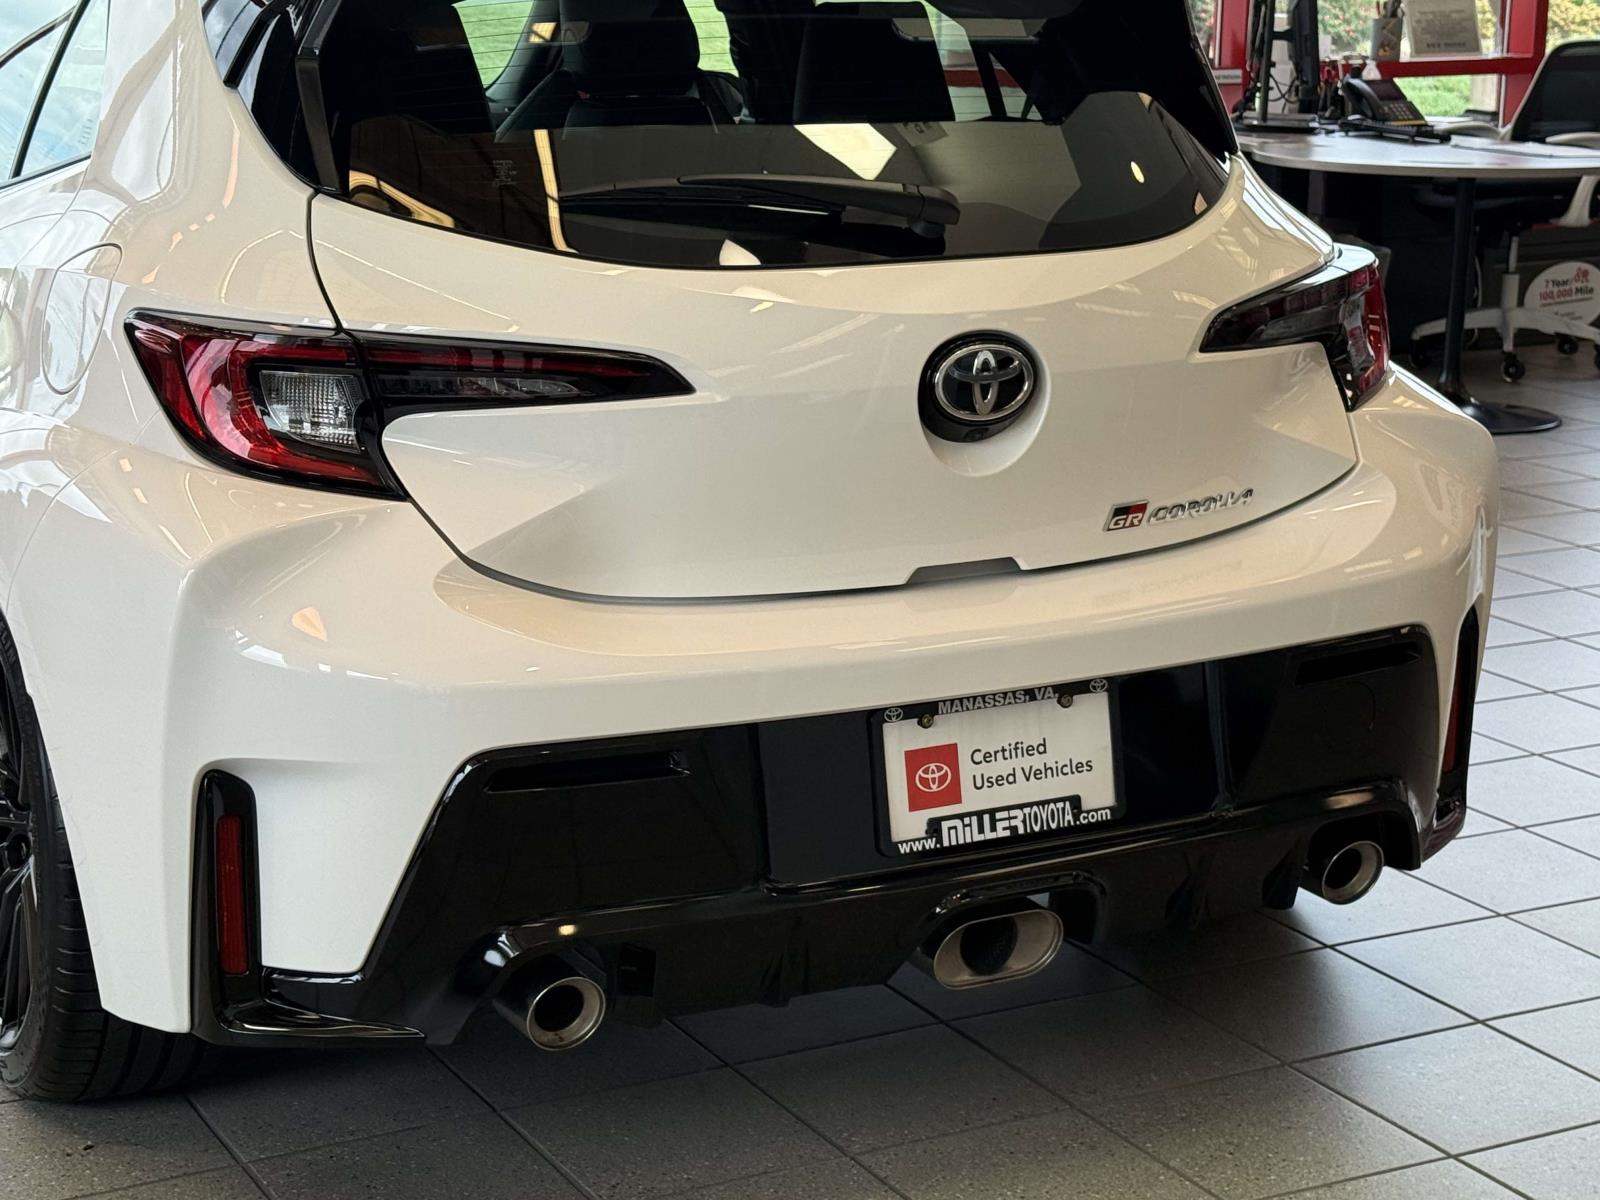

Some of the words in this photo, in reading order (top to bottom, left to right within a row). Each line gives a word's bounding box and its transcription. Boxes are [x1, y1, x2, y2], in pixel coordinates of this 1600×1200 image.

[1575, 286, 1594, 297] Mile
[1108, 512, 1143, 530] GR
[1147, 487, 1254, 525] COROLLA
[938, 692, 1030, 715] MANASSAS,
[1035, 686, 1059, 702] VA.
[970, 737, 1047, 765] Certified
[972, 767, 1017, 790] Used
[1021, 757, 1094, 782] Vehicles
